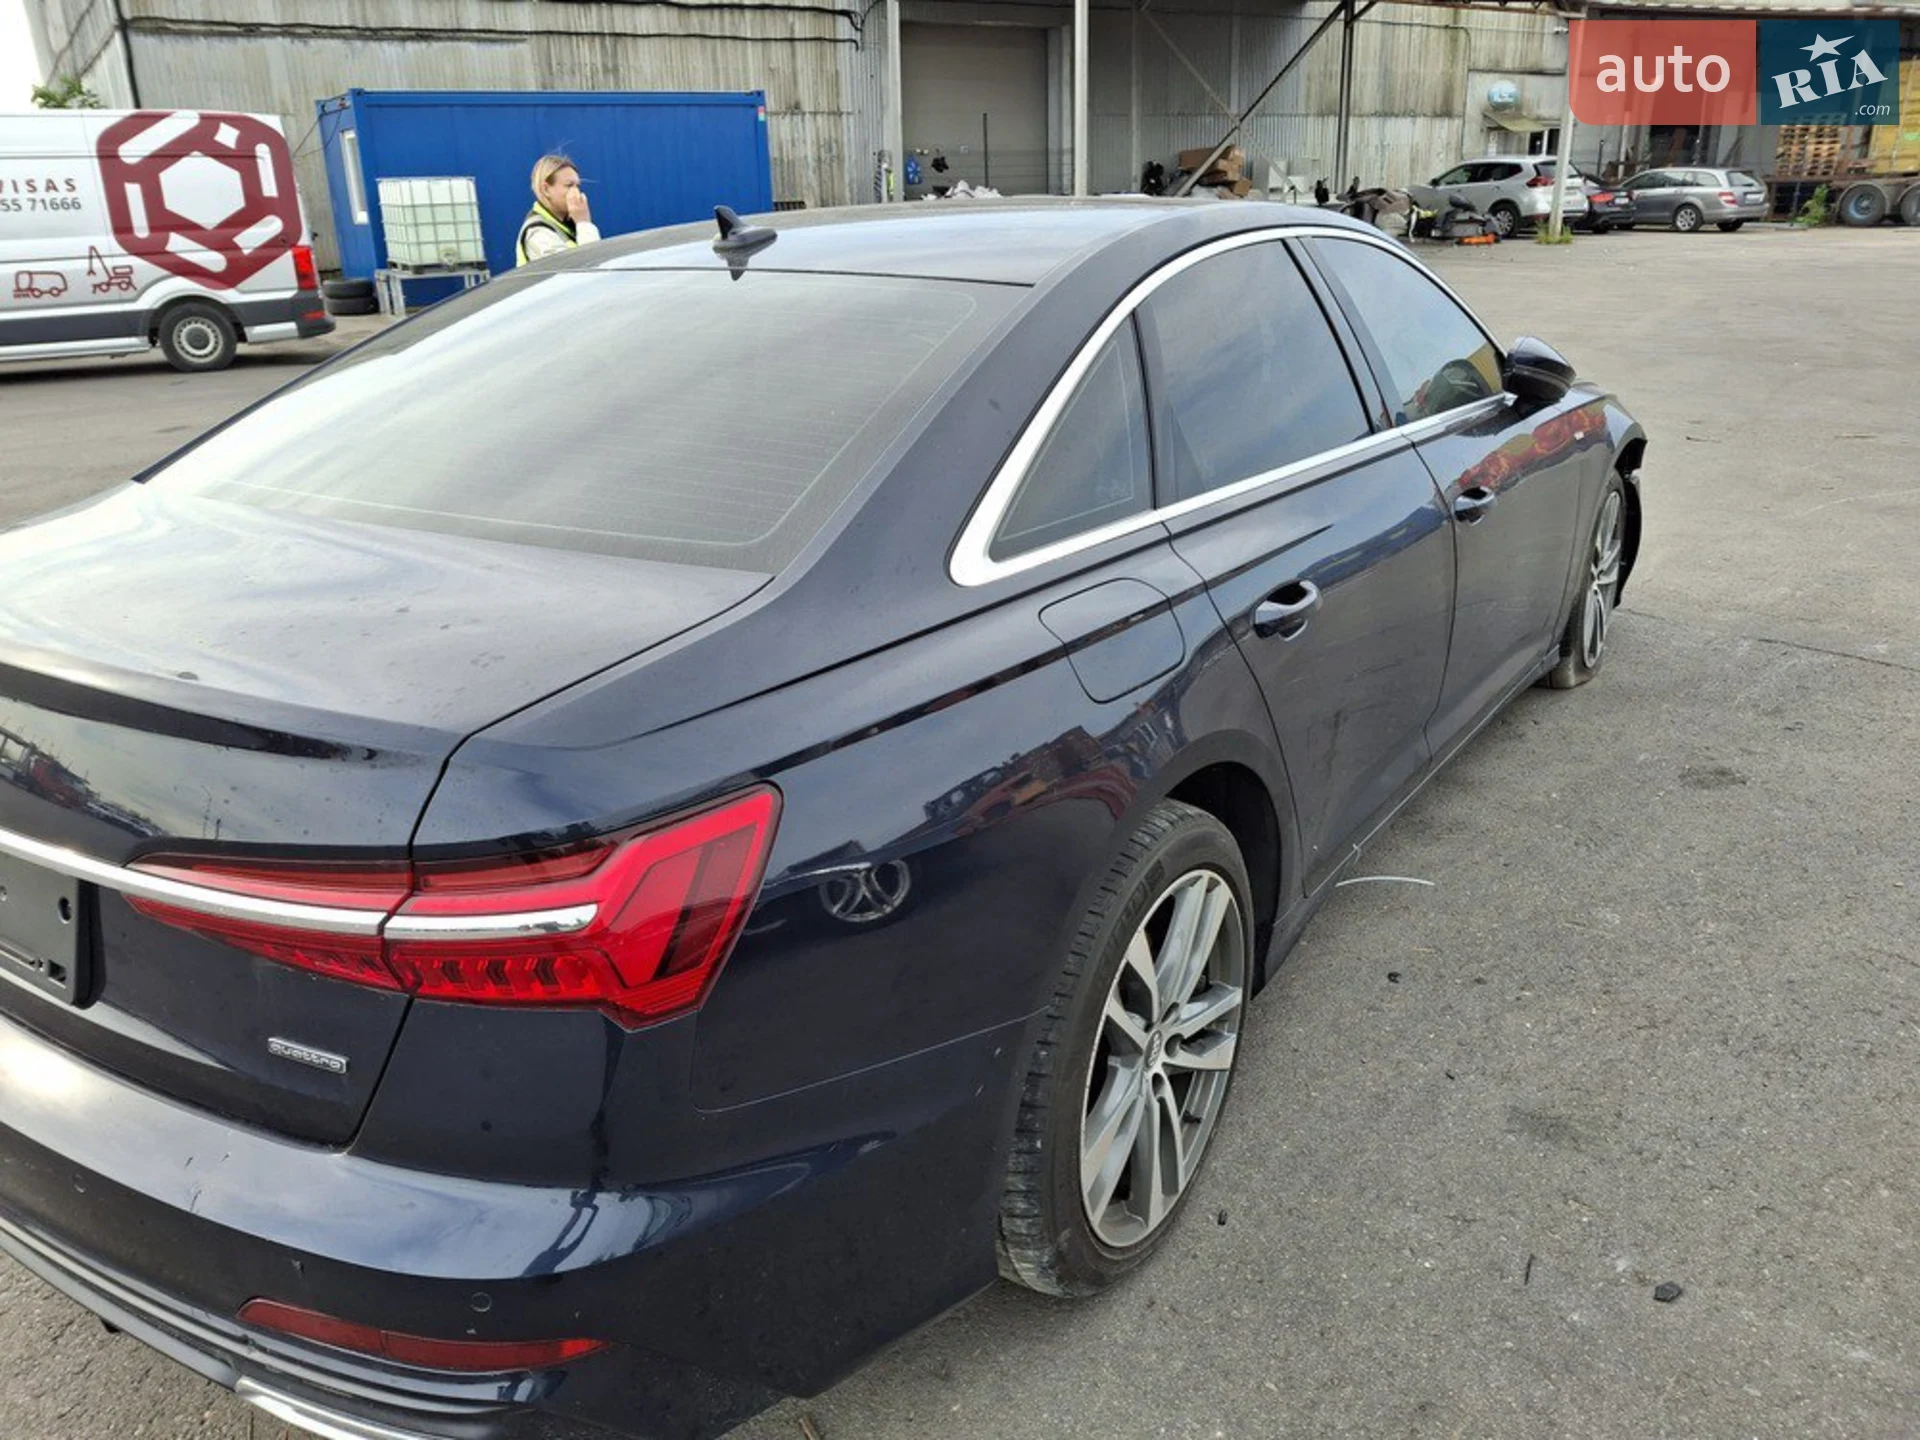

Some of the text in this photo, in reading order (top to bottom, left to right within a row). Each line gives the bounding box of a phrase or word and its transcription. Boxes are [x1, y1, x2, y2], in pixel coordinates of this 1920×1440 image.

[0, 178, 76, 193] ISAS
[26, 197, 82, 210] 71666
[269, 1041, 343, 1071] quattro
